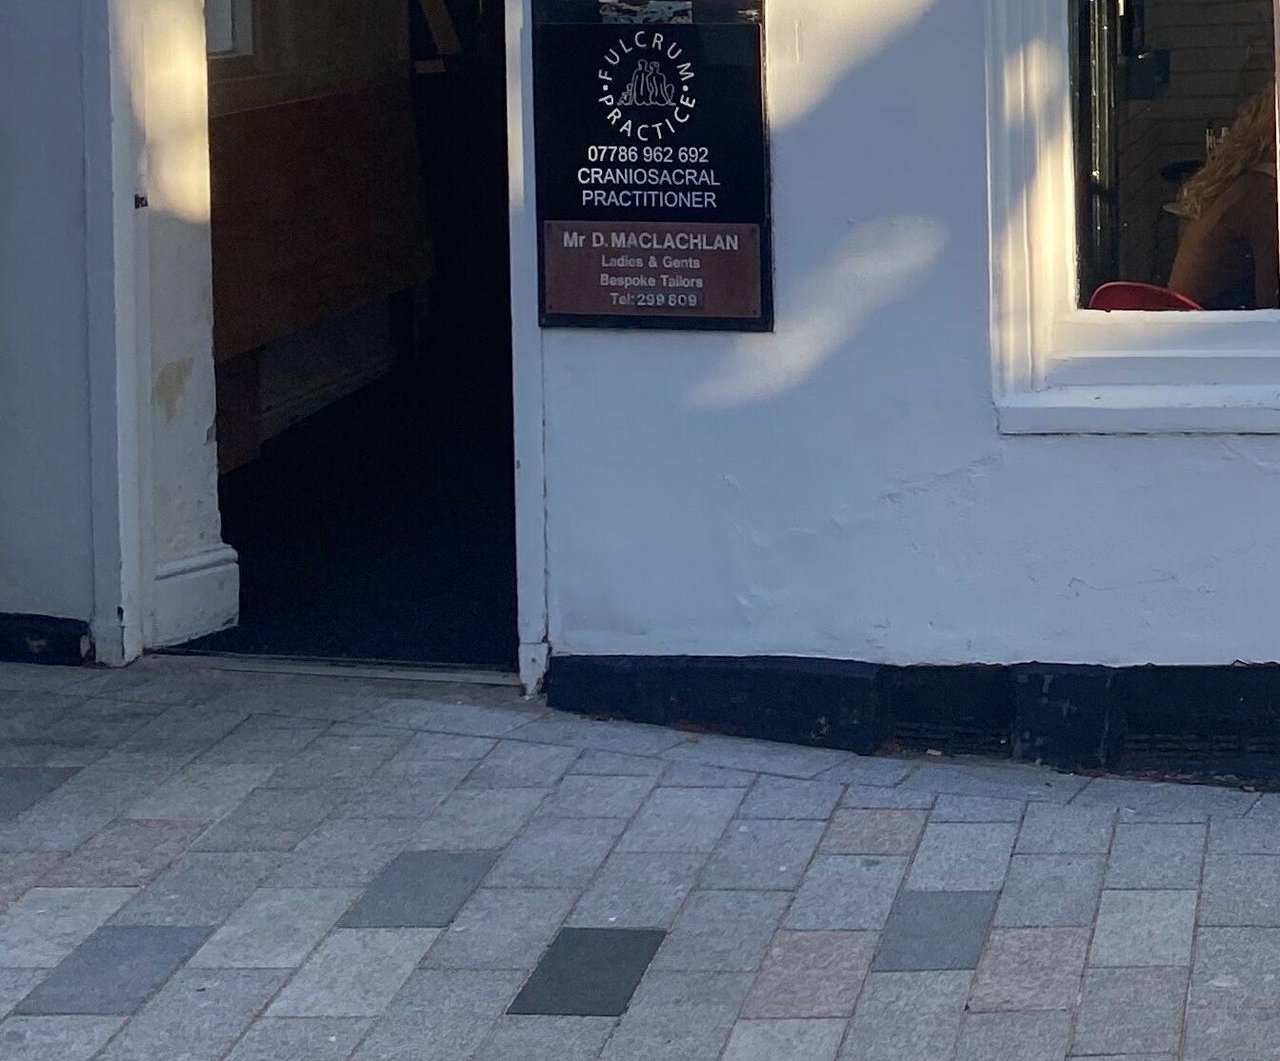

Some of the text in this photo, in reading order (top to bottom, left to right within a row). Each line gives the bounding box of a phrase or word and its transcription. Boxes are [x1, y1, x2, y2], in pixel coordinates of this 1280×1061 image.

[599, 30, 695, 82] FULCRUM
[599, 94, 696, 141] PRACTICE
[588, 146, 709, 163] 07786 962 692
[577, 167, 721, 186] CRANIOSACRAL
[582, 190, 717, 208] PRACTITIONER
[563, 231, 585, 248] Mr
[611, 232, 739, 251] MACLACHLAN
[601, 254, 701, 269] Ladies & Gents
[600, 273, 704, 289] Bespoke Tailors
[668, 293, 698, 307] 809
